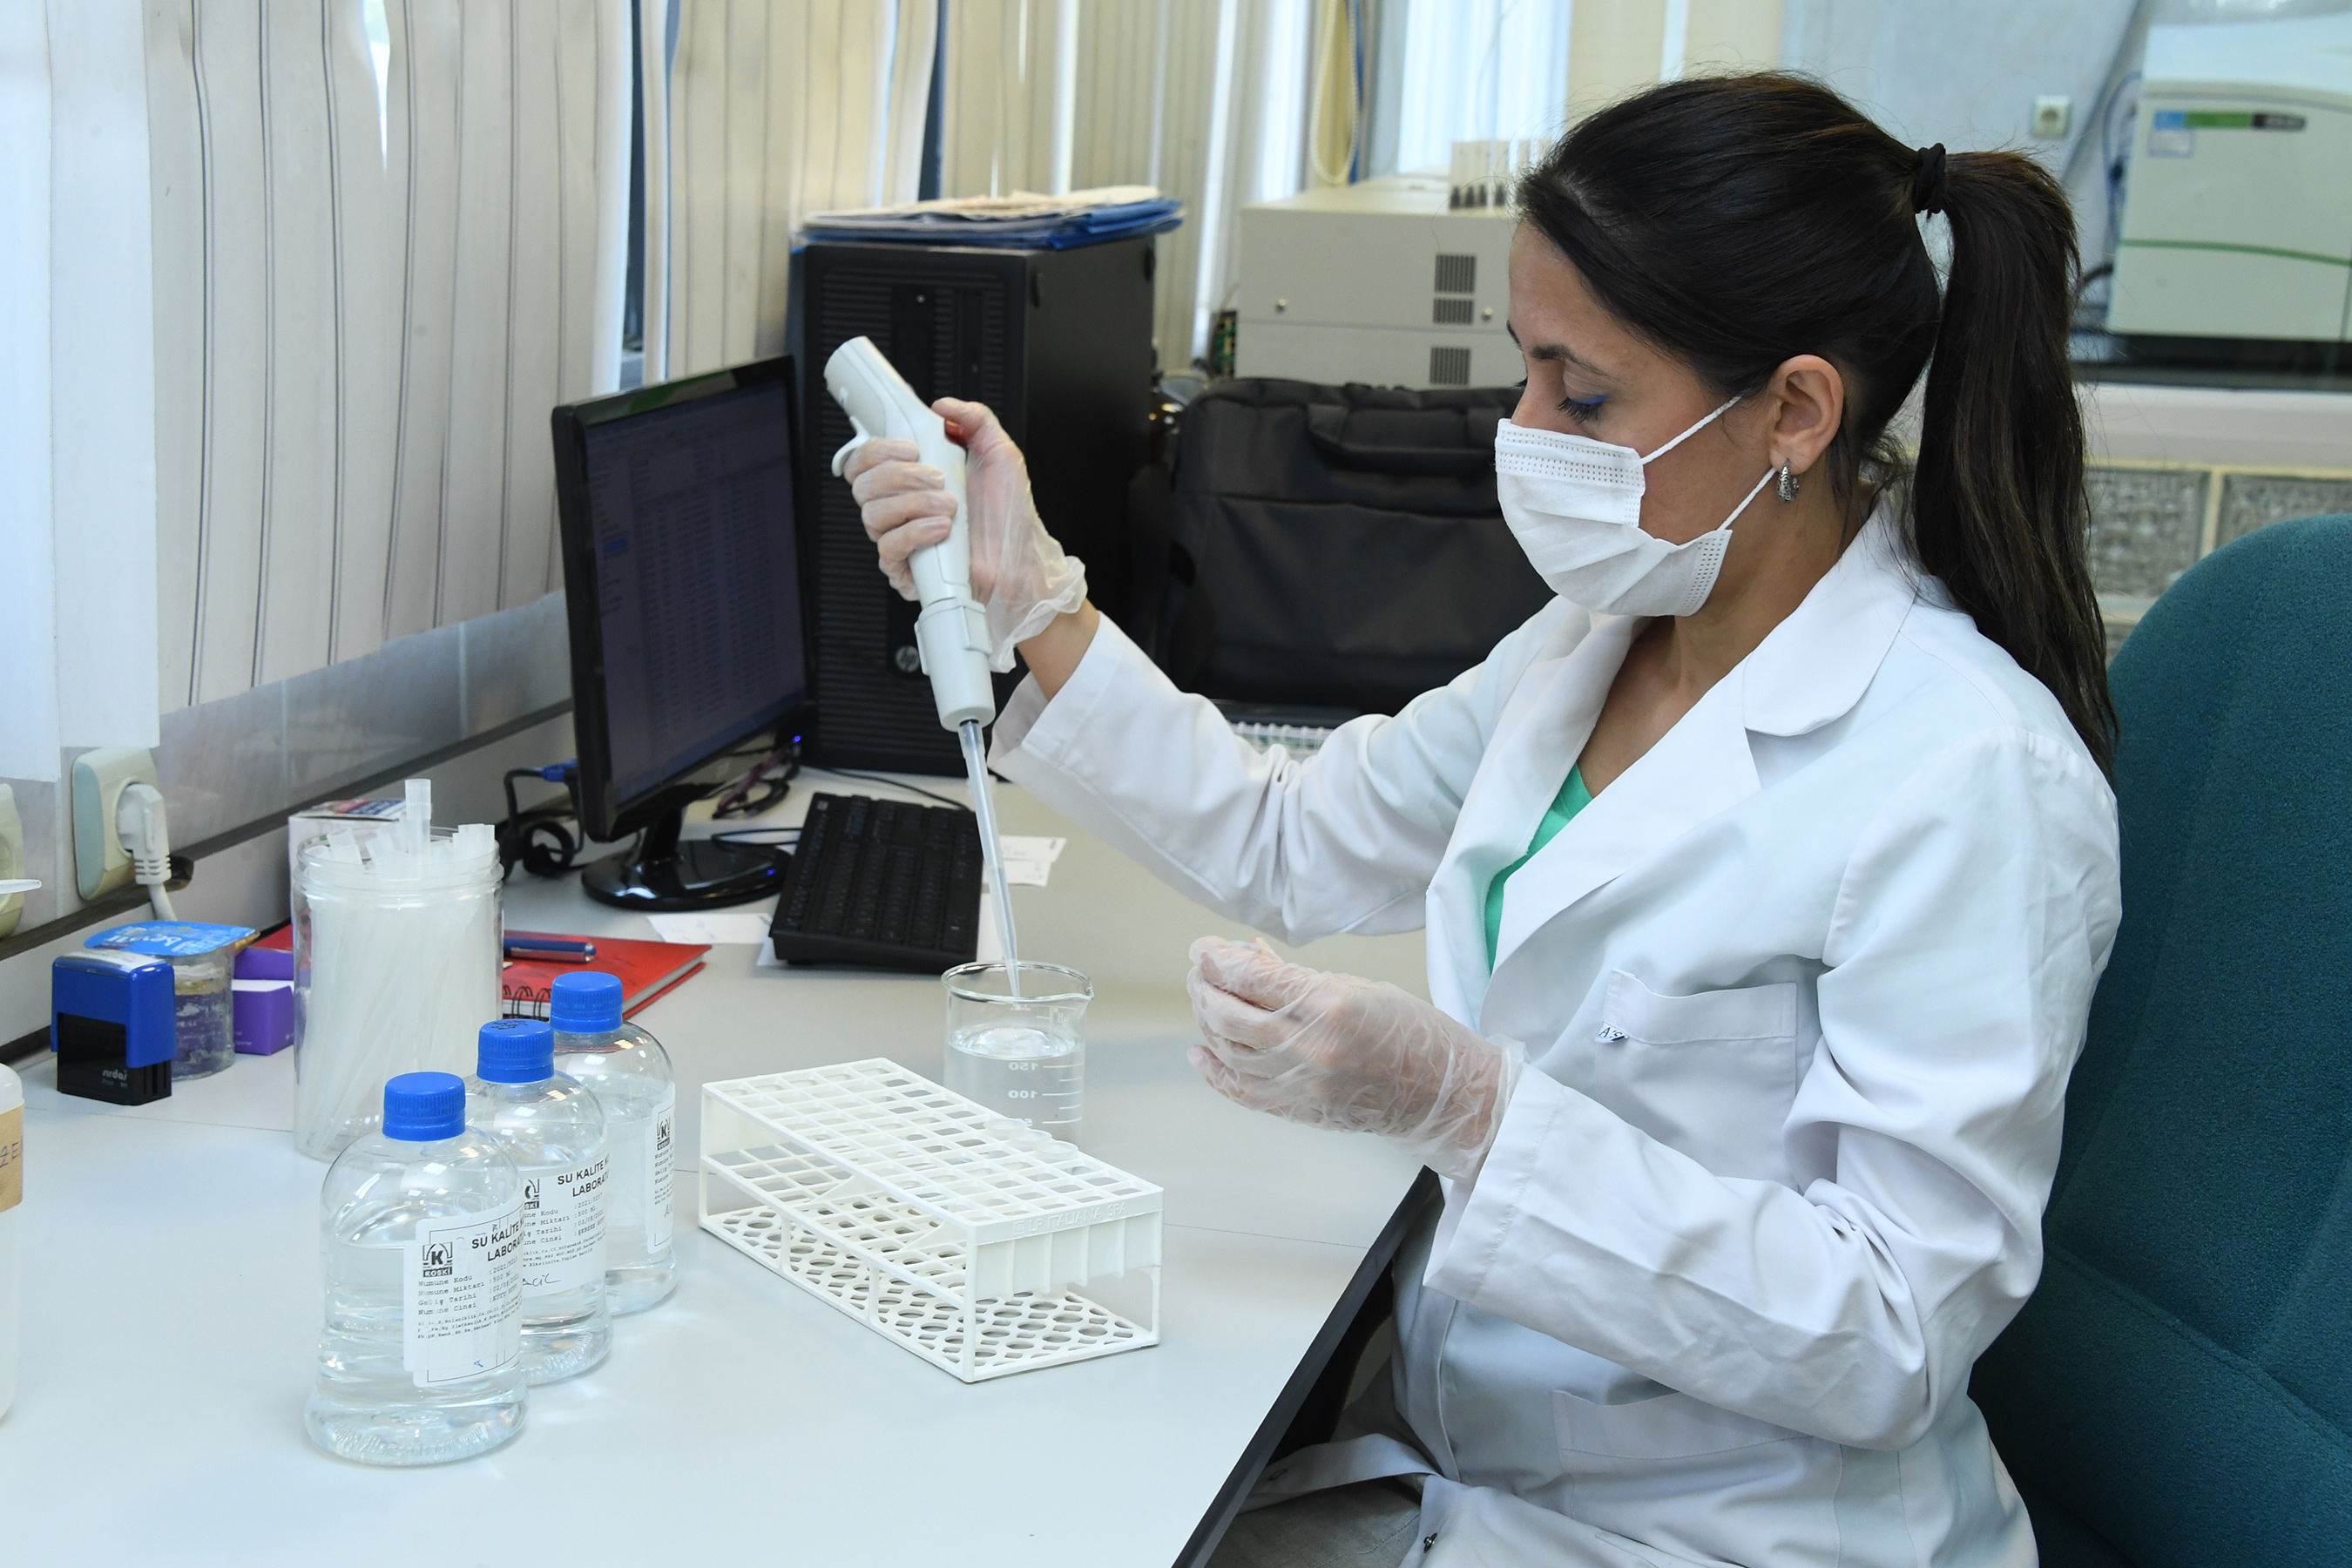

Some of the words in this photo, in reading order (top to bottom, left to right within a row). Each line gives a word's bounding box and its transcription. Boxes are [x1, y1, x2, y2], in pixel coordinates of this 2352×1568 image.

[558, 1173, 573, 1186] SU
[471, 1235, 488, 1249] SU
[431, 1250, 444, 1266] K
[453, 1274, 472, 1283] Kodu
